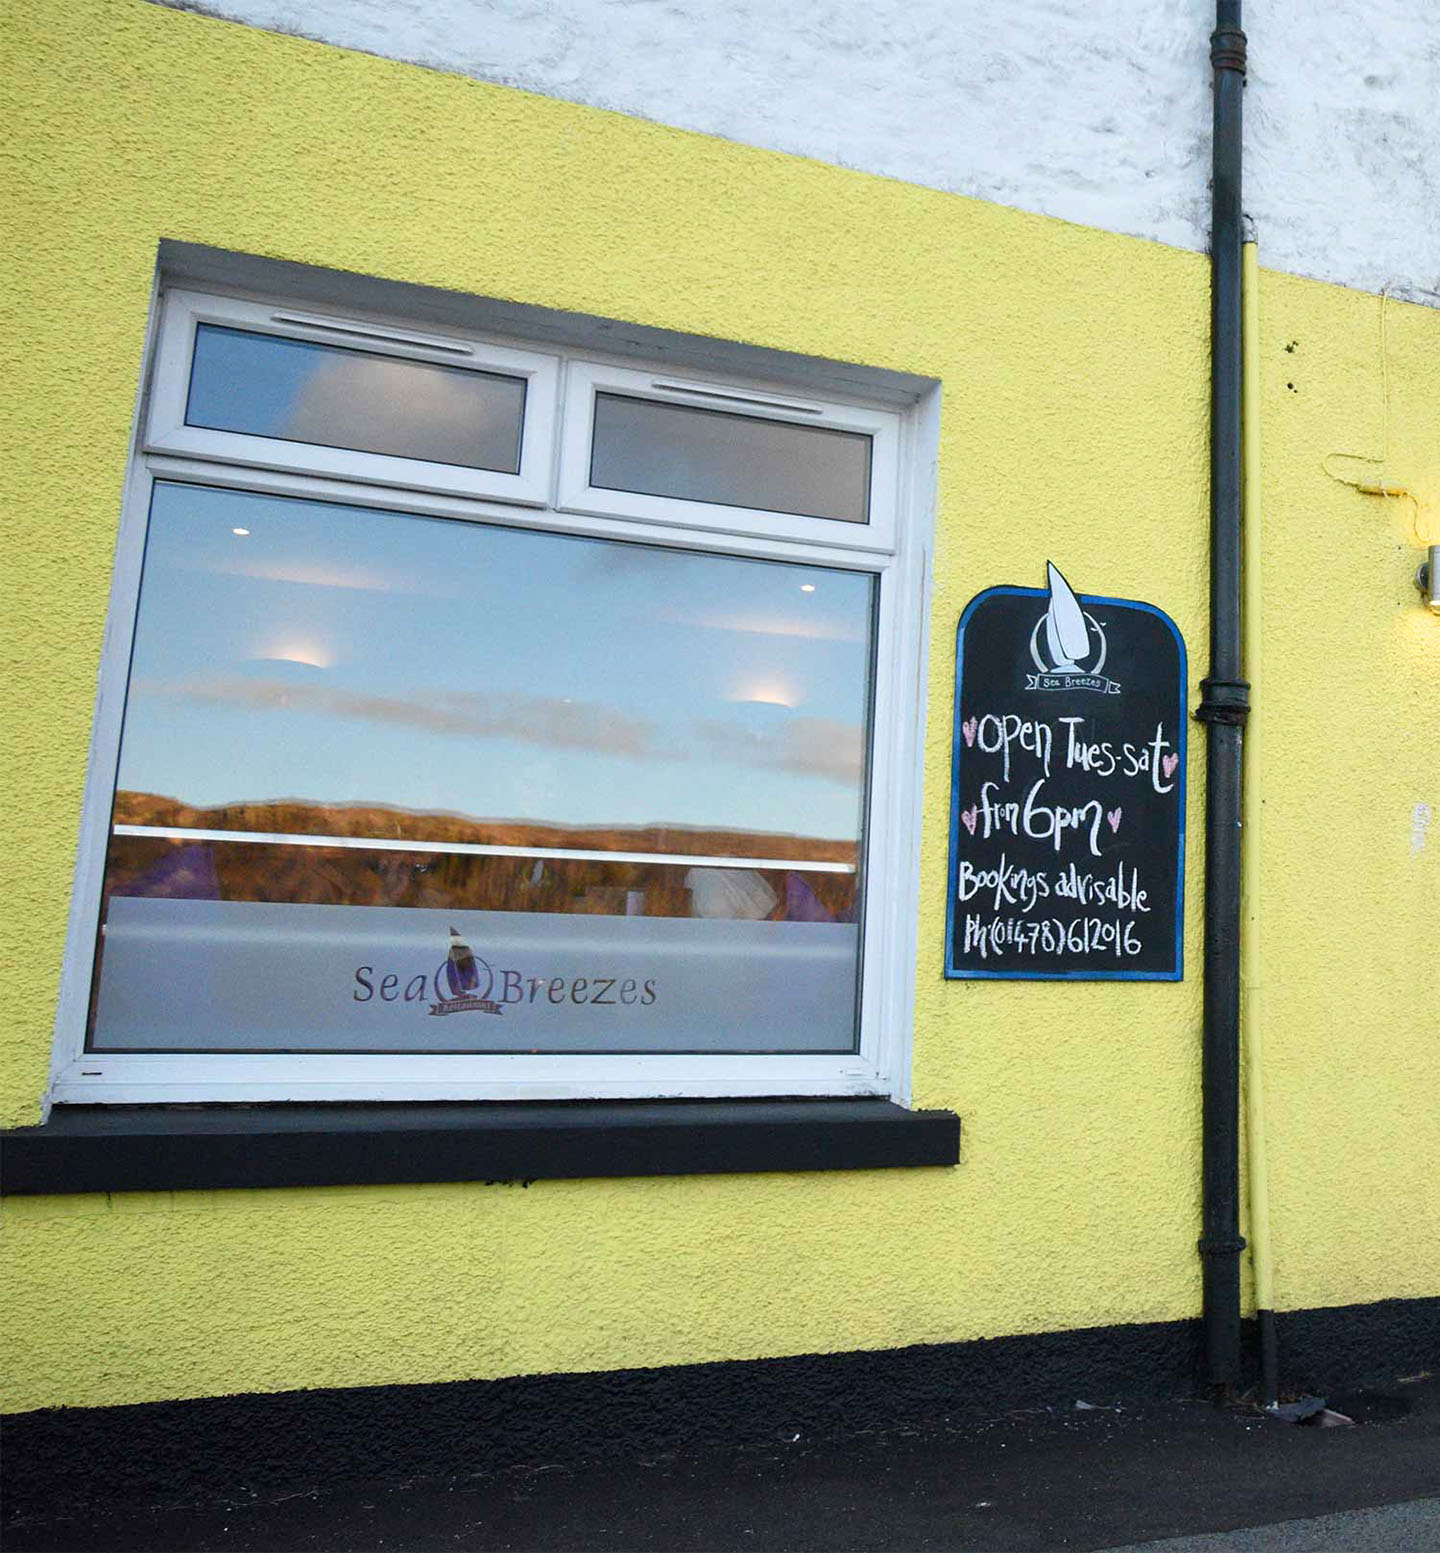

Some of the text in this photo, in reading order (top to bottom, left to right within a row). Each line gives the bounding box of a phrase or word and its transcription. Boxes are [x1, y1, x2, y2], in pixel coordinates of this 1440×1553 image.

[1043, 676, 1102, 688] Sea Breezes
[977, 713, 1052, 782] Open
[1023, 778, 1102, 856] 6pm
[958, 852, 1151, 913] Bookings advisable
[352, 965, 658, 1006] Sea Breezes
